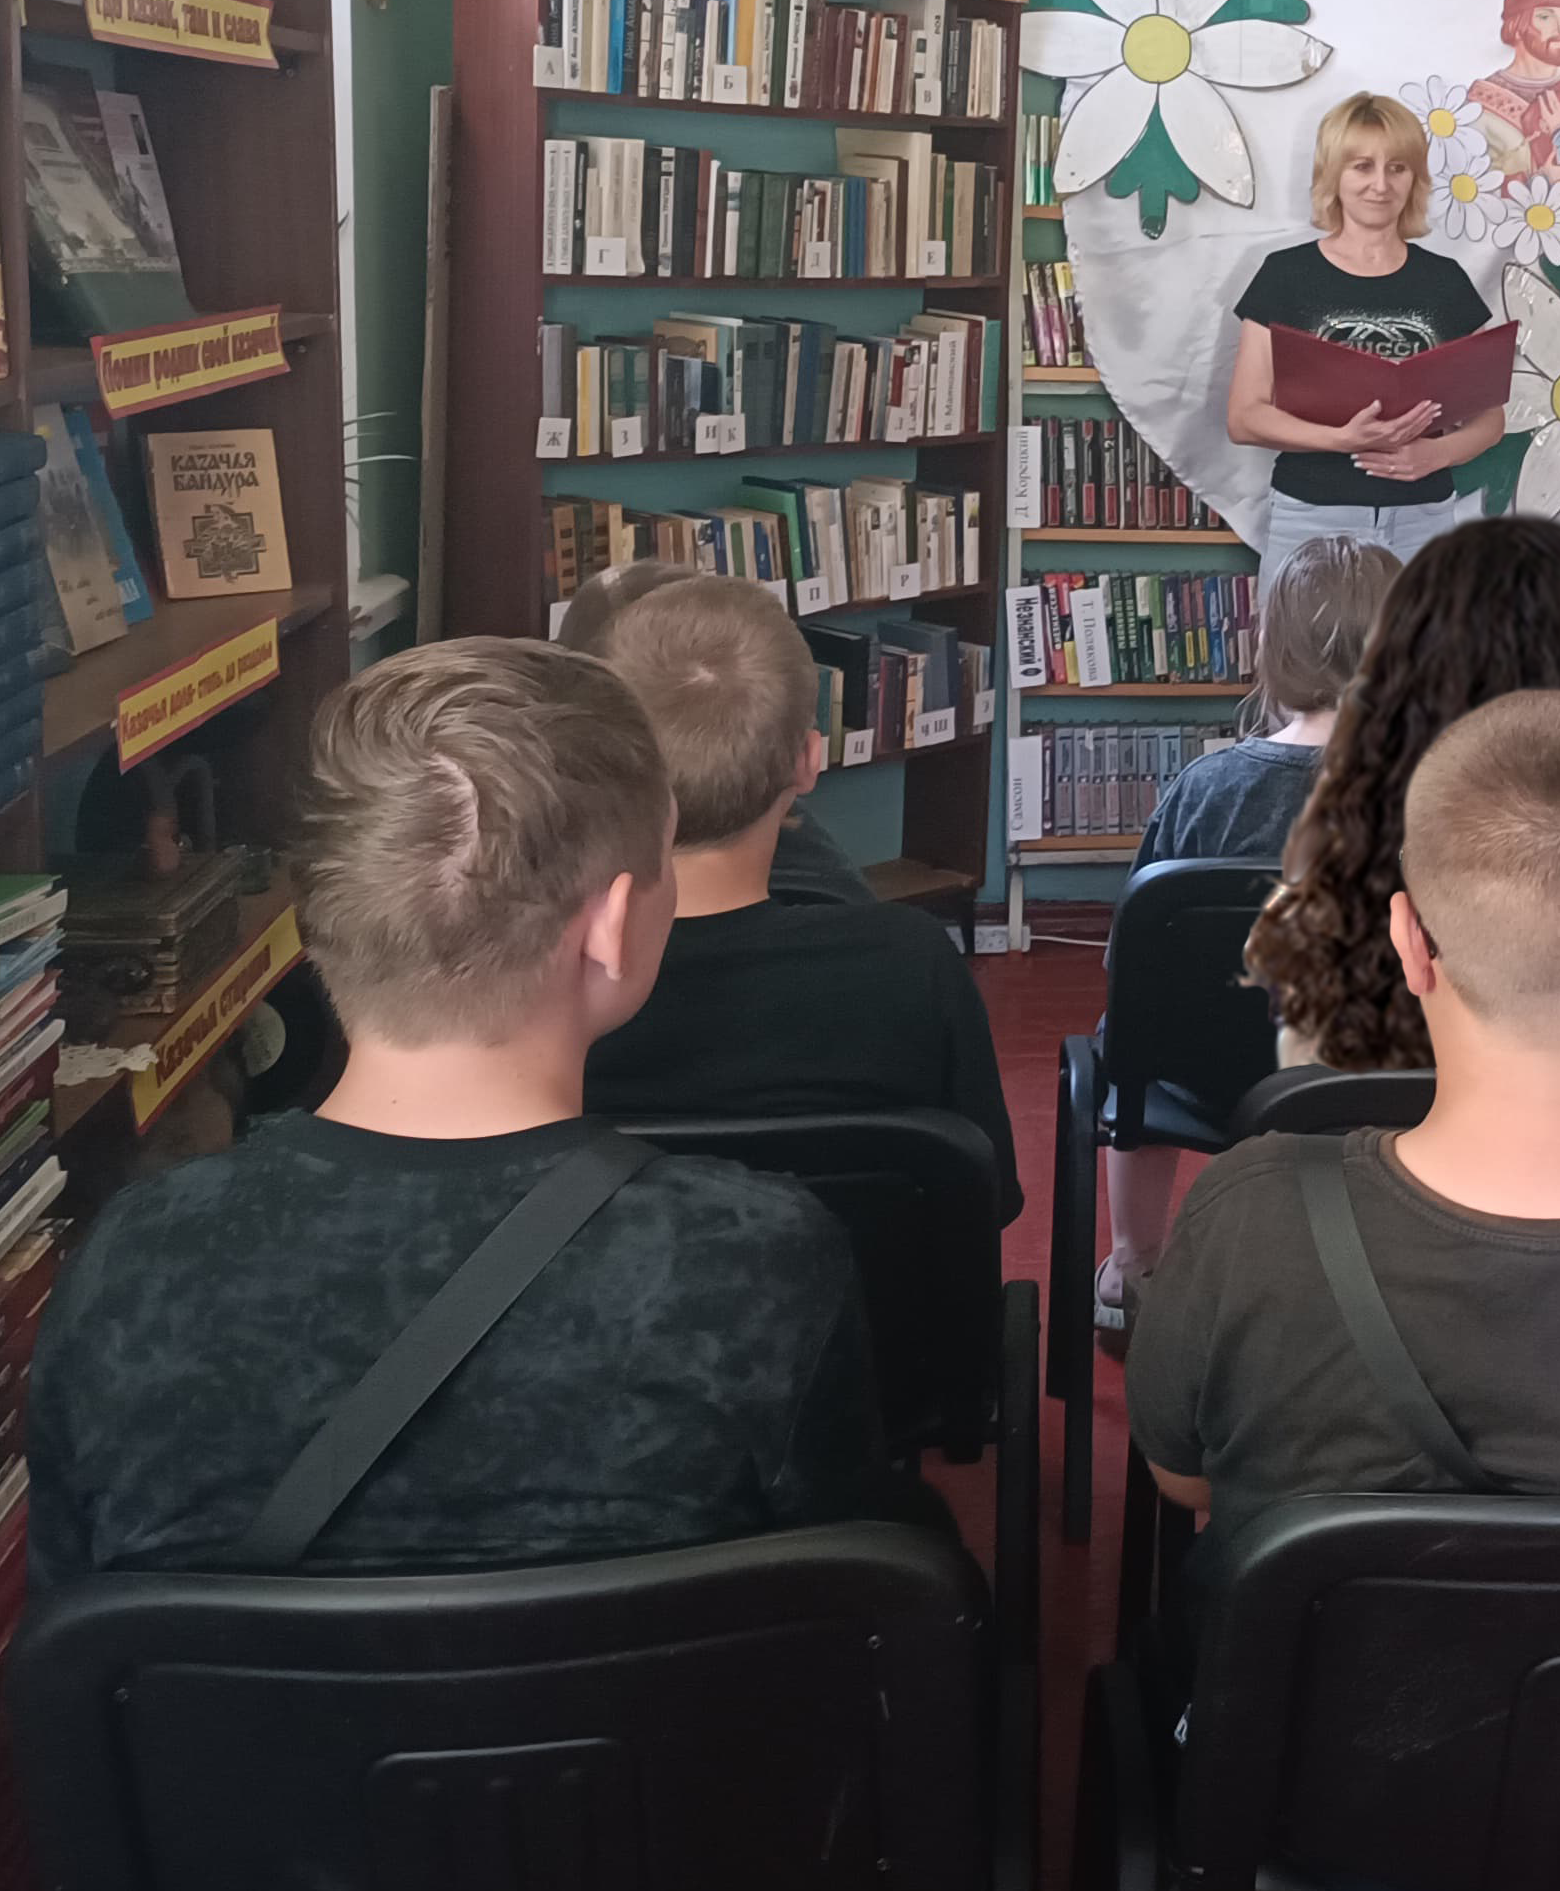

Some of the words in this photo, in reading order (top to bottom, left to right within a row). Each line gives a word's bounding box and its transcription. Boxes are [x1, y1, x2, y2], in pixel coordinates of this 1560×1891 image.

[723, 75, 735, 89] Б
[598, 249, 611, 264] Г
[944, 340, 957, 418] Маяковский
[546, 431, 563, 446] Ж
[728, 428, 737, 443] К
[1015, 430, 1031, 500] Корецкий
[173, 471, 260, 498] БАНДУРА
[1015, 506, 1029, 518] Д.
[900, 573, 909, 587] Р
[810, 587, 820, 600] П
[1016, 597, 1041, 666] Незнанский
[1084, 617, 1097, 682] Полякова
[1011, 778, 1023, 831] Самсон
